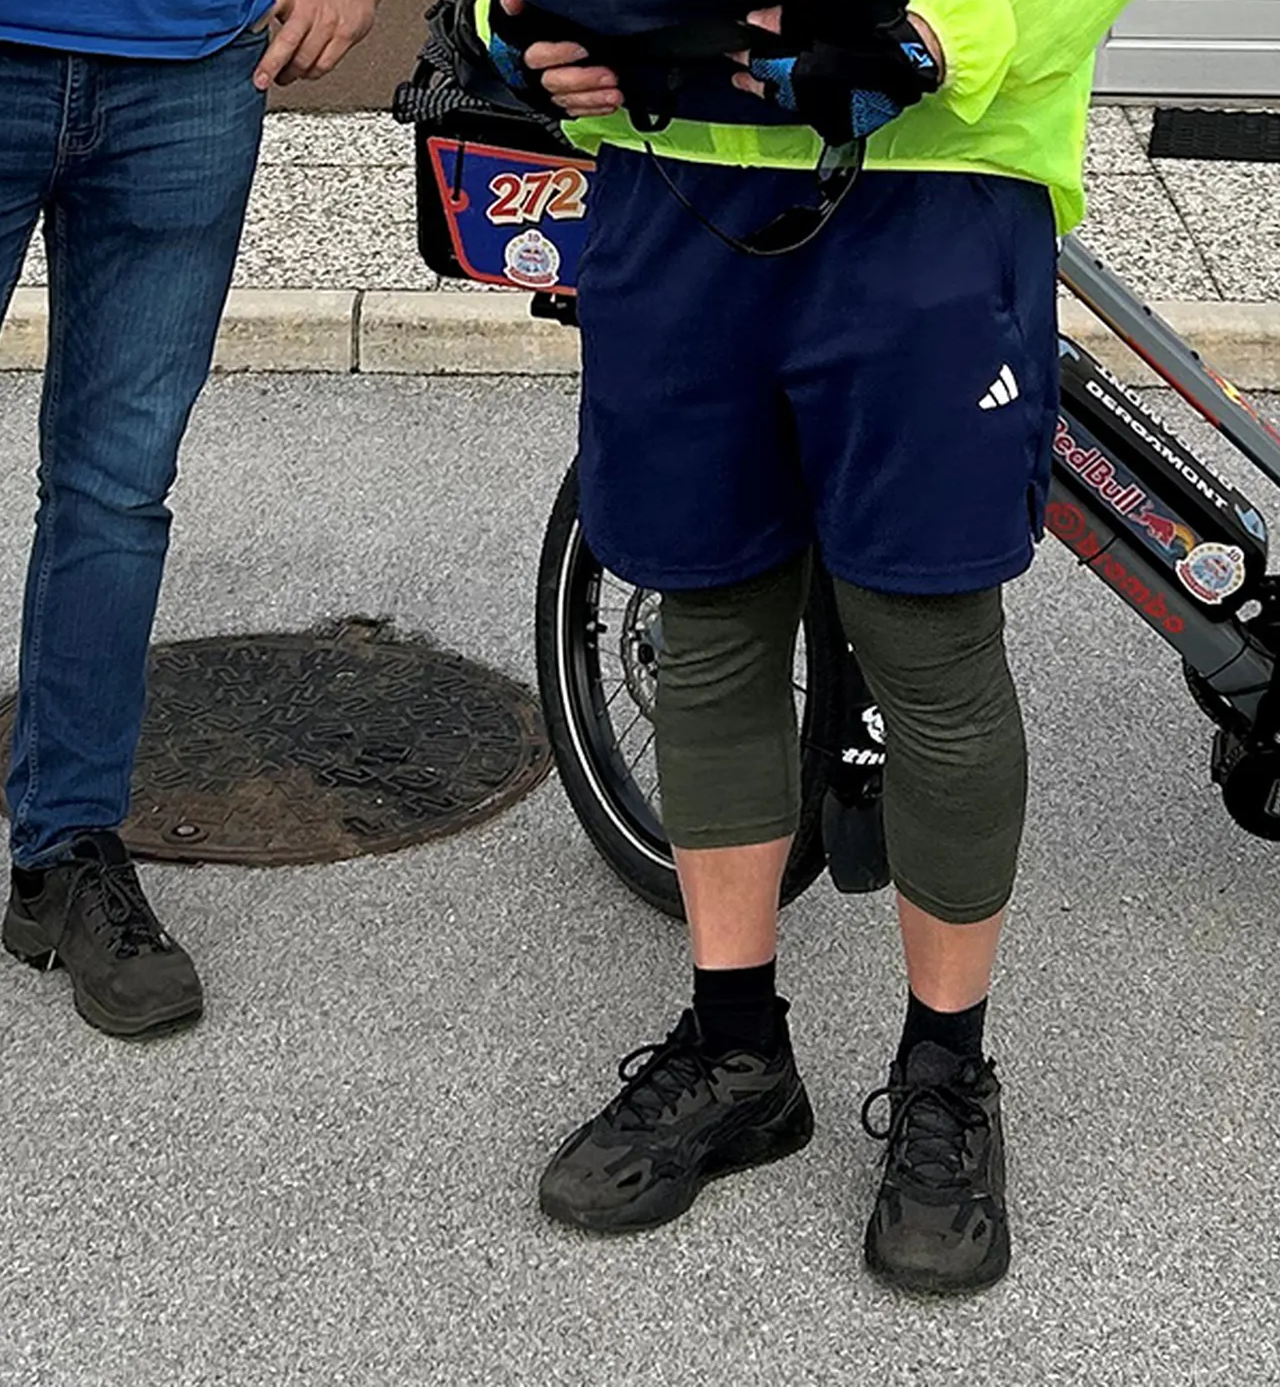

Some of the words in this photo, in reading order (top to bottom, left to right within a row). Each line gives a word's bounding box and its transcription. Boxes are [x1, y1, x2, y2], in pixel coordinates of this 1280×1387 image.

[486, 168, 589, 224] 272
[1085, 380, 1228, 508] BERGAMONT
[1074, 531, 1185, 633] brembo
